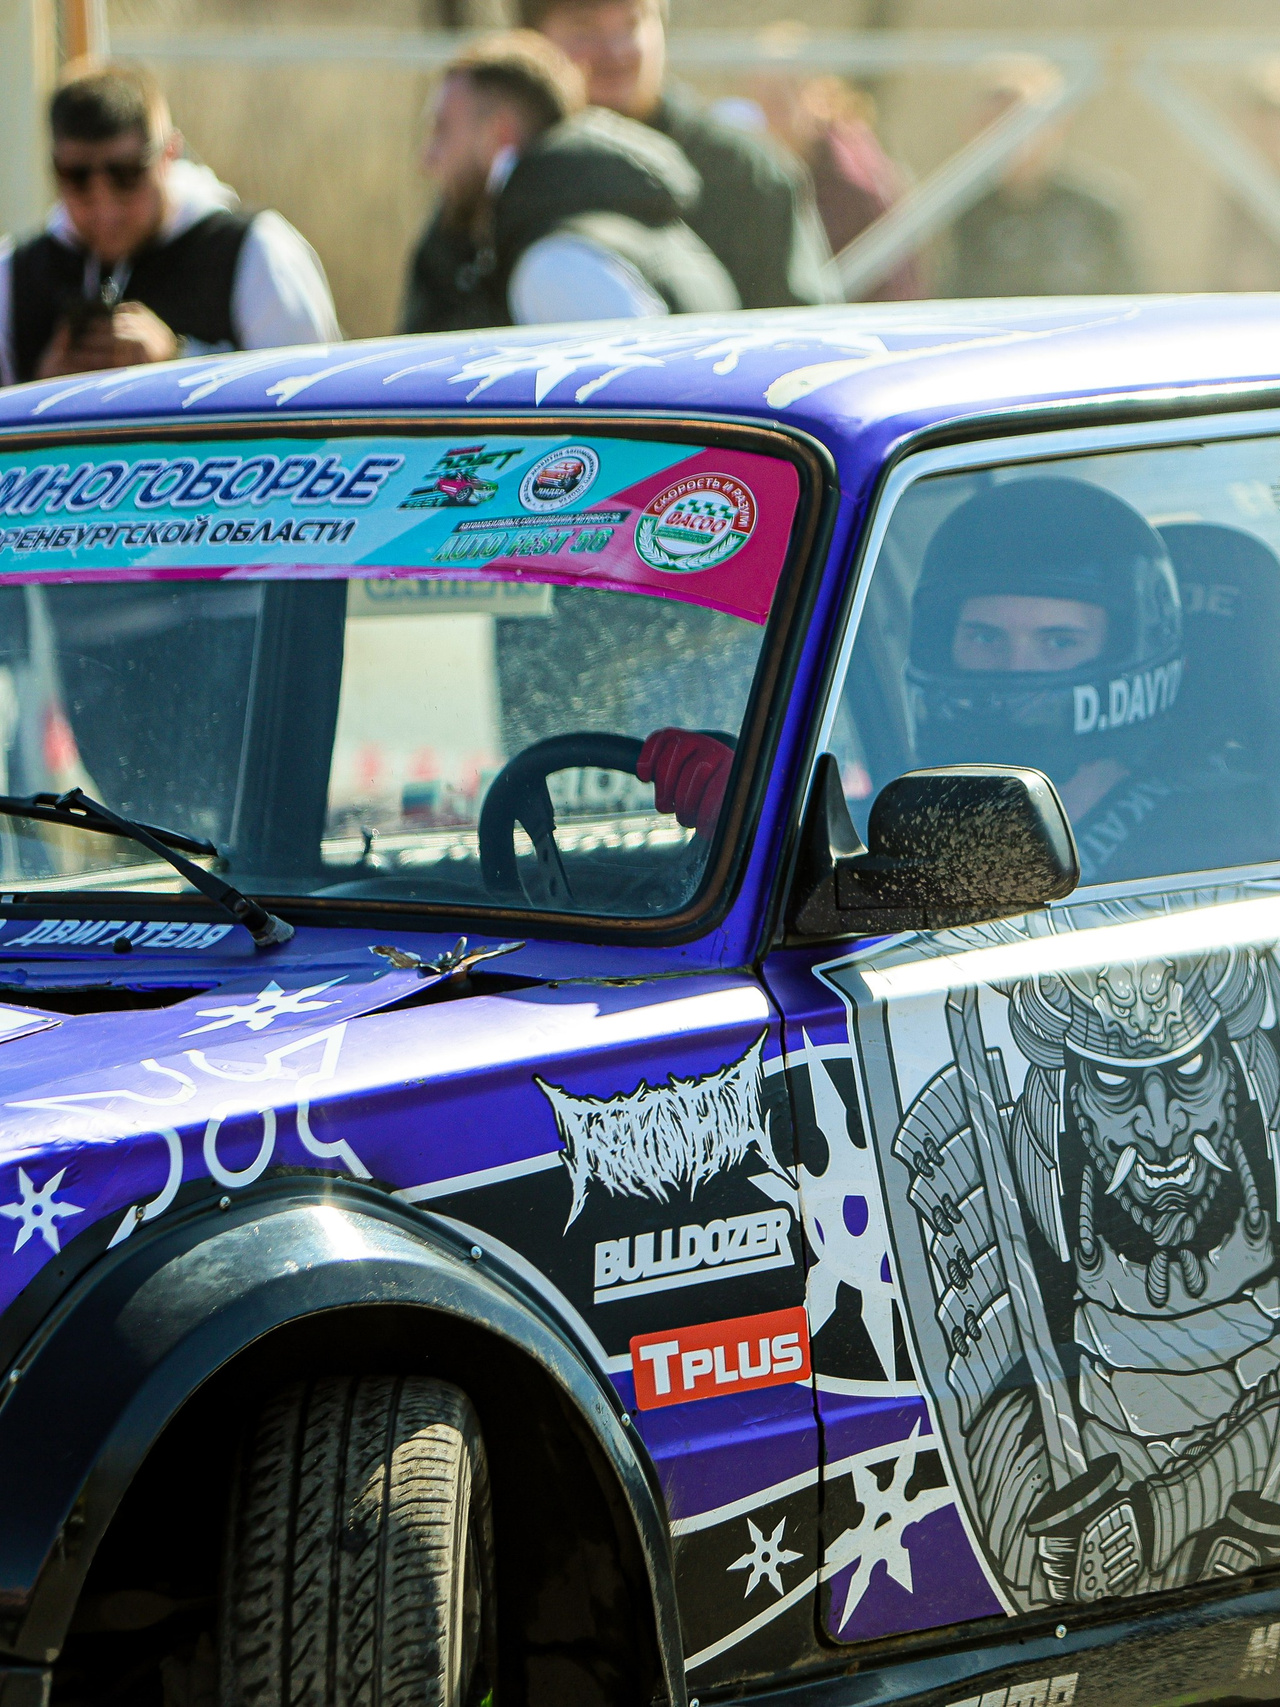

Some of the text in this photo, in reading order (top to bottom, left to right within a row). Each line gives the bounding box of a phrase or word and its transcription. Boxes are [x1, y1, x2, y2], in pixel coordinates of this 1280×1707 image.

[654, 478, 750, 528] СКОРОСТЬ И РАЗУМ
[208, 519, 358, 547] ОБЛАСТИ
[432, 526, 615, 562] AUTO FEST 56
[3, 918, 234, 949] ДВИГАТЕЛЯ
[594, 1209, 792, 1292] BULLDOZER
[639, 1332, 802, 1396] TPLUS
